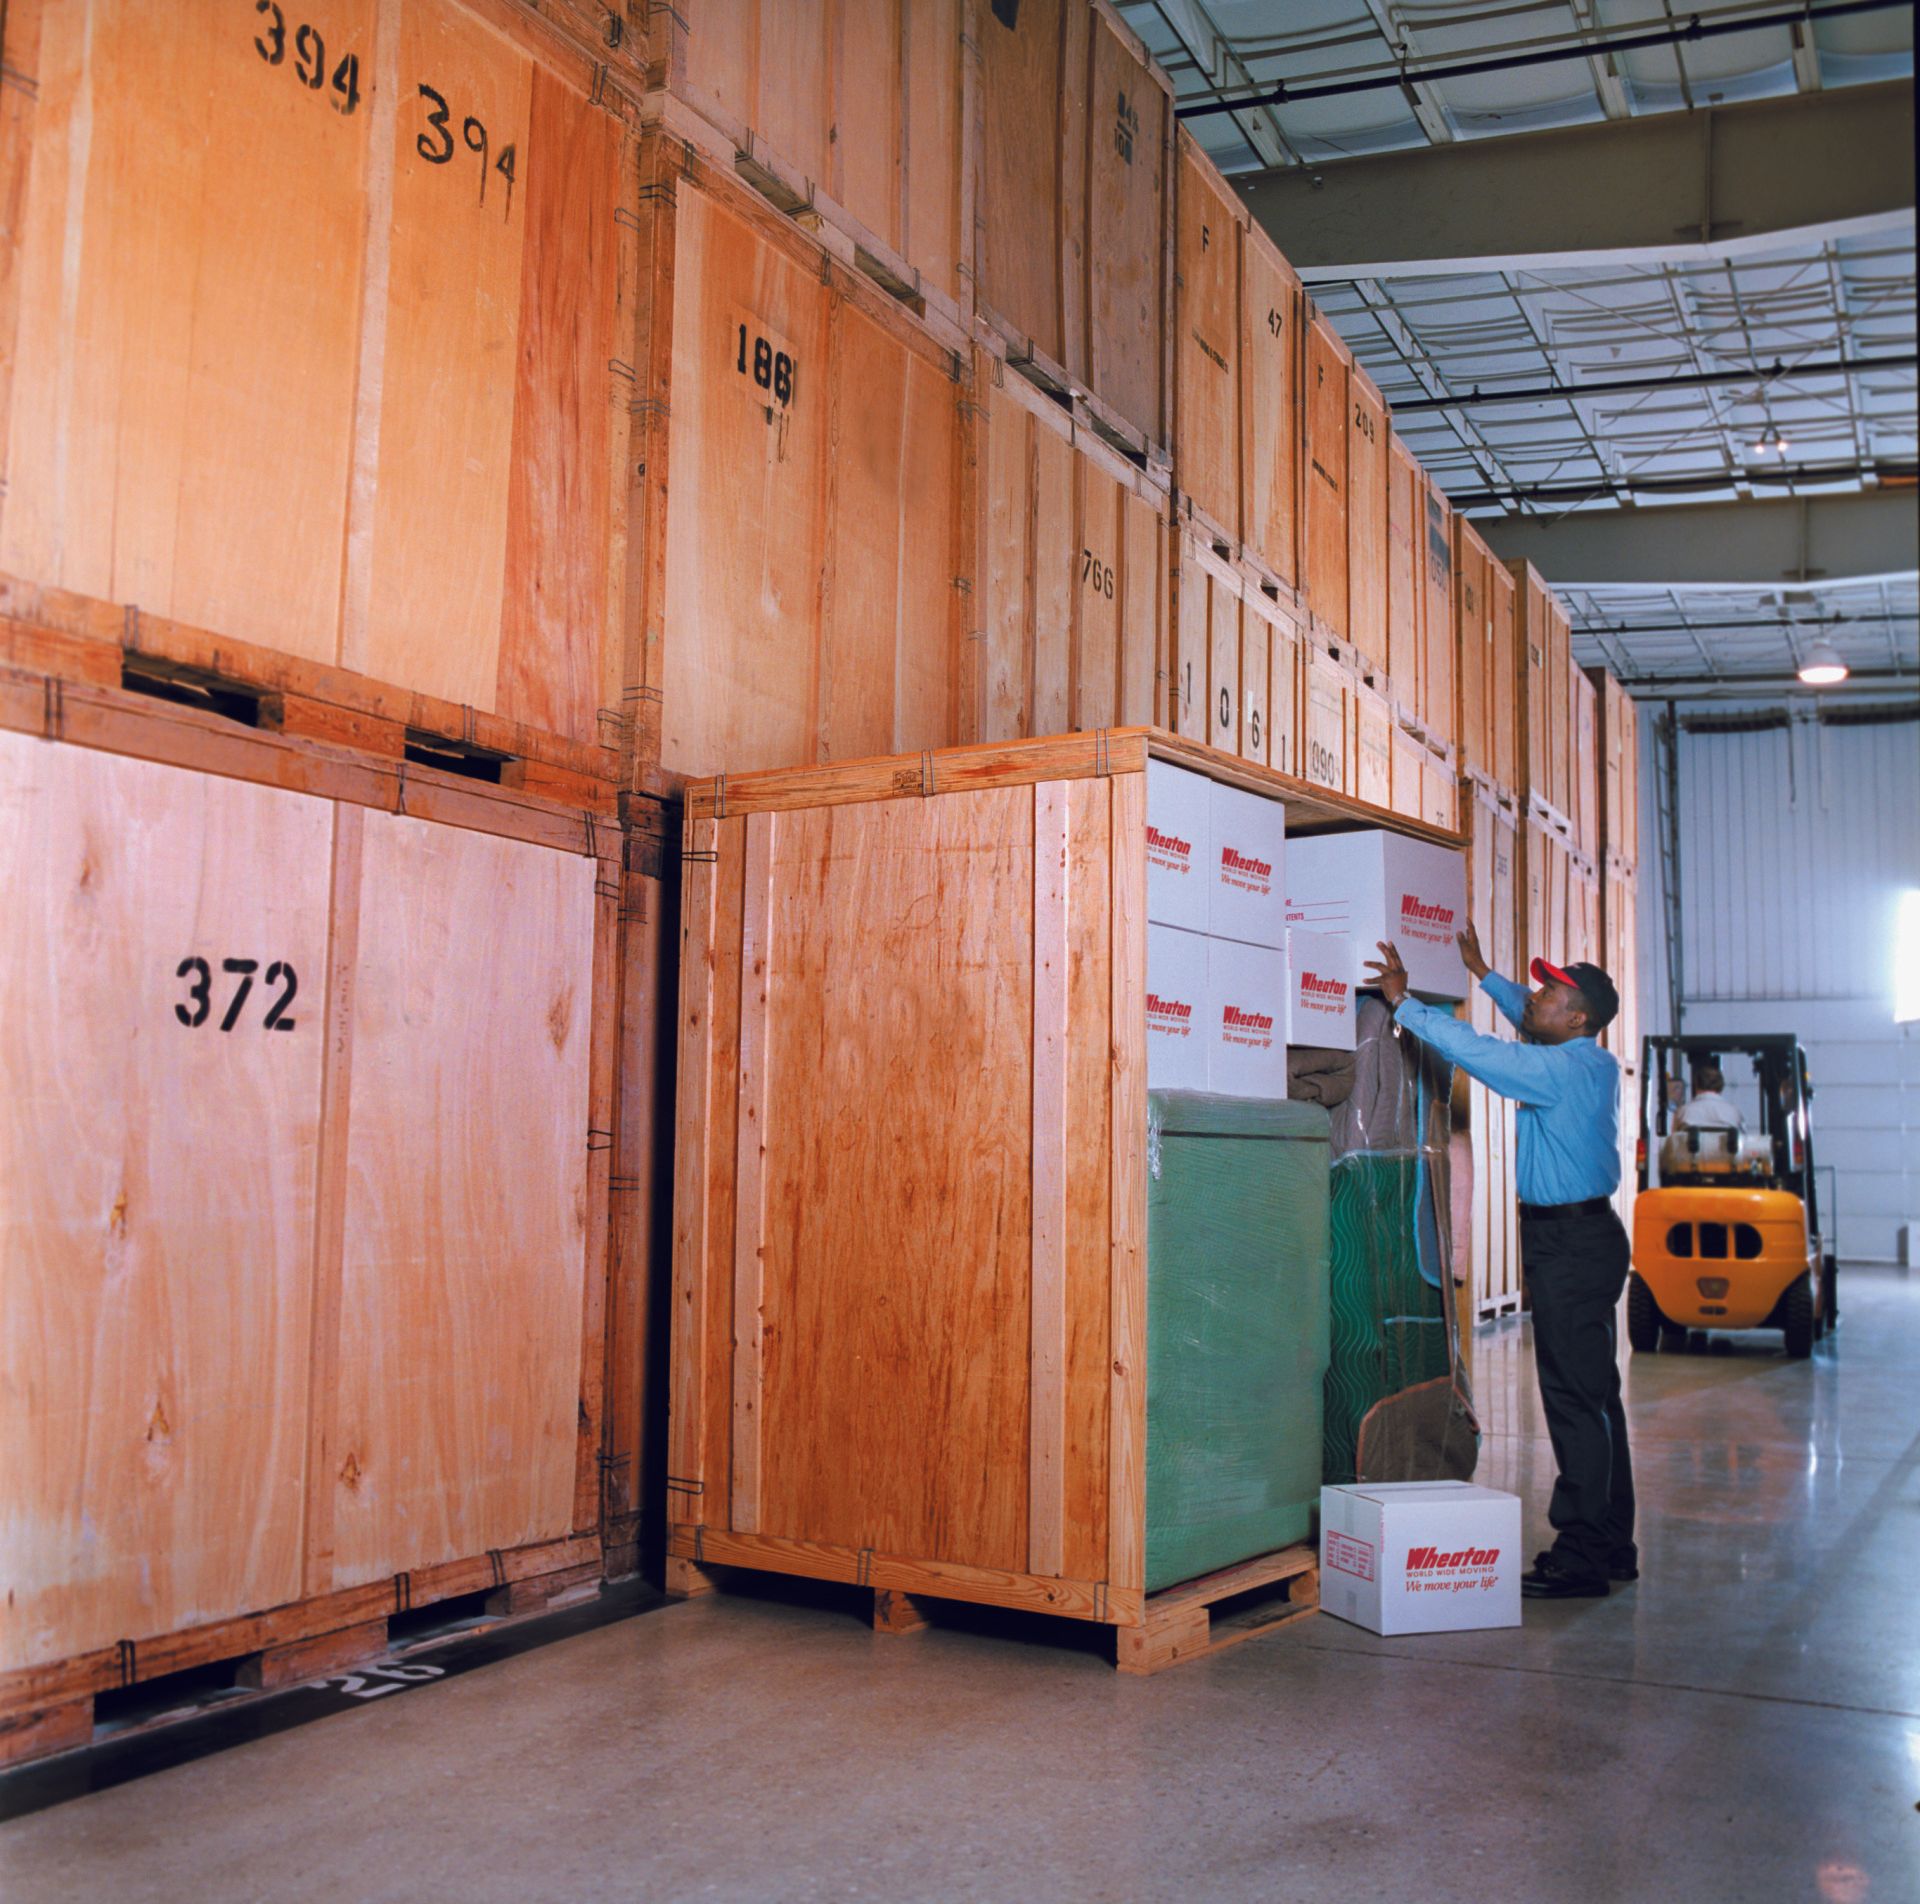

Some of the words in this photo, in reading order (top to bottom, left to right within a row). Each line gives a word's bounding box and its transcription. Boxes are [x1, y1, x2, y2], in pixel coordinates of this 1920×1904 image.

[255, 0, 360, 116] 394
[417, 83, 516, 214] 394
[1202, 224, 1209, 252] F
[1268, 308, 1282, 339] 47
[1355, 402, 1374, 444] 209
[1083, 549, 1113, 600] 766
[1221, 846, 1272, 876] Wheaton
[1401, 893, 1454, 923] Wheaton
[175, 956, 297, 1032] 372
[1301, 971, 1348, 995] Wheaton
[1223, 1005, 1273, 1029] Wheaton
[1406, 1546, 1500, 1570] Wheaton
[1406, 1570, 1434, 1578] WORLD
[1459, 1566, 1495, 1575] MOVING
[1406, 1580, 1422, 1592] We
[1424, 1581, 1451, 1592] move
[1452, 1580, 1478, 1593] your
